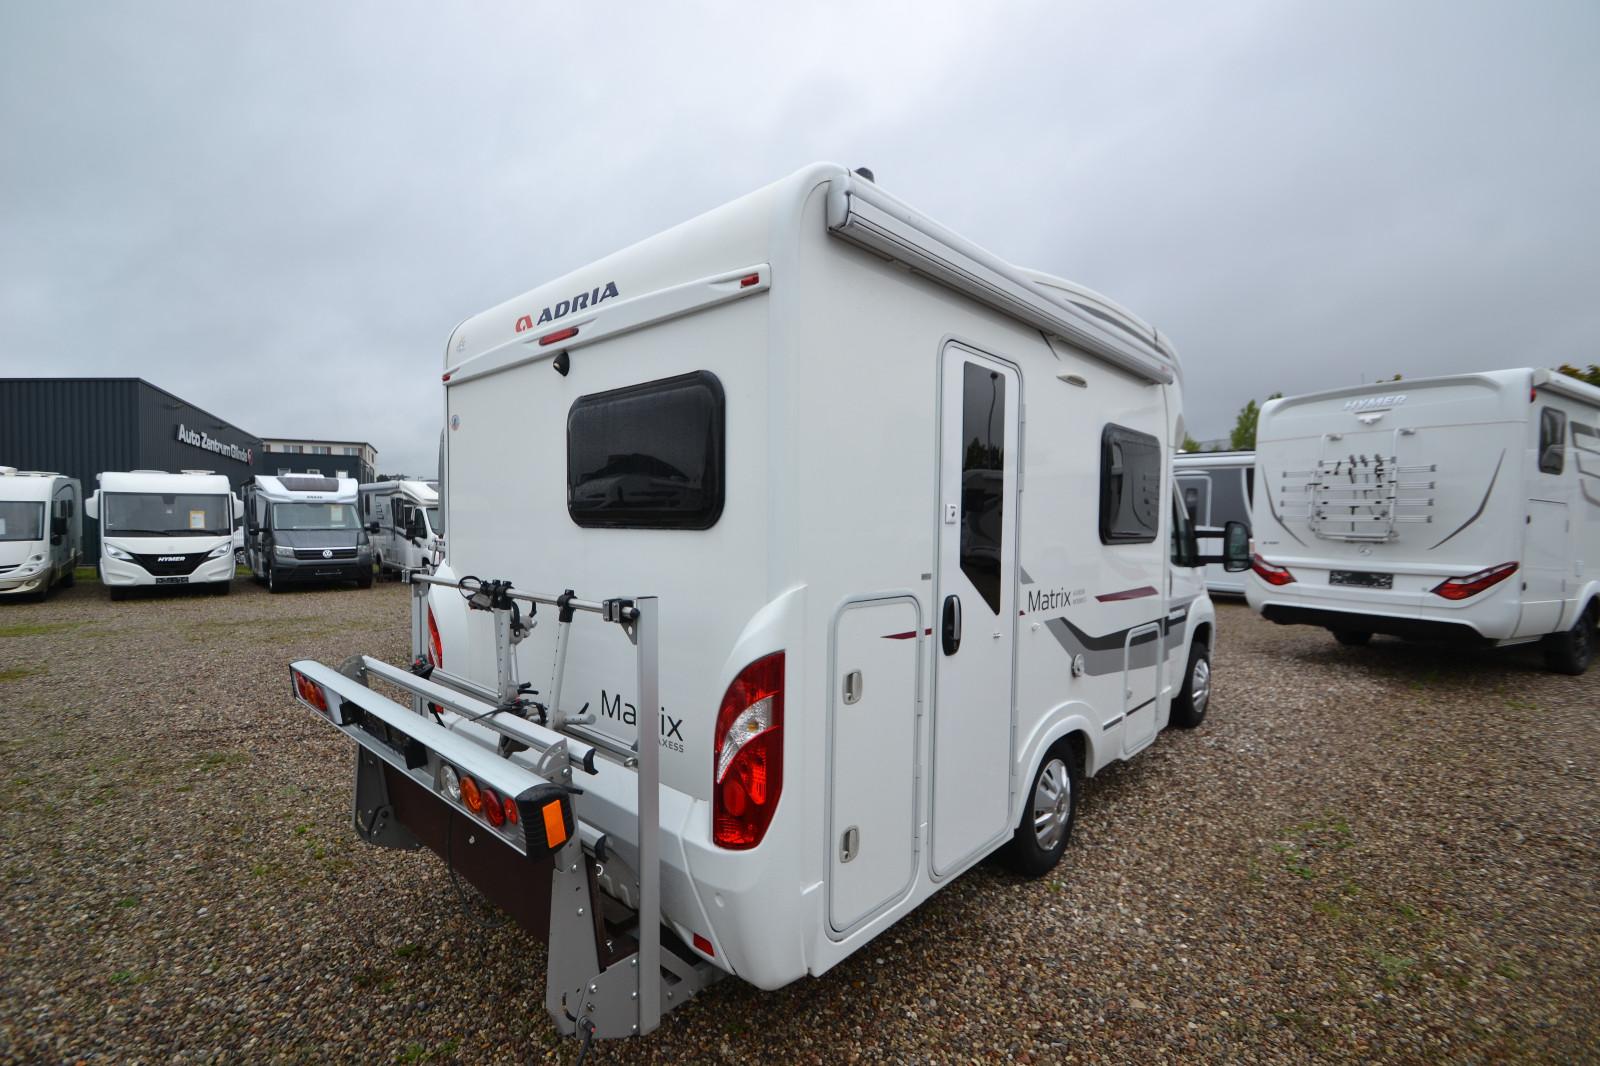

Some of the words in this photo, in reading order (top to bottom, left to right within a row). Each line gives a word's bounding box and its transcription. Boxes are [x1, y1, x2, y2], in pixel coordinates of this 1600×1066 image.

[537, 281, 619, 326] ADRIA
[178, 423, 200, 446] Auto
[201, 432, 230, 457] Zentrum
[1028, 586, 1071, 612] Matrix
[601, 689, 684, 742] Maix
[659, 738, 684, 752] XESS
